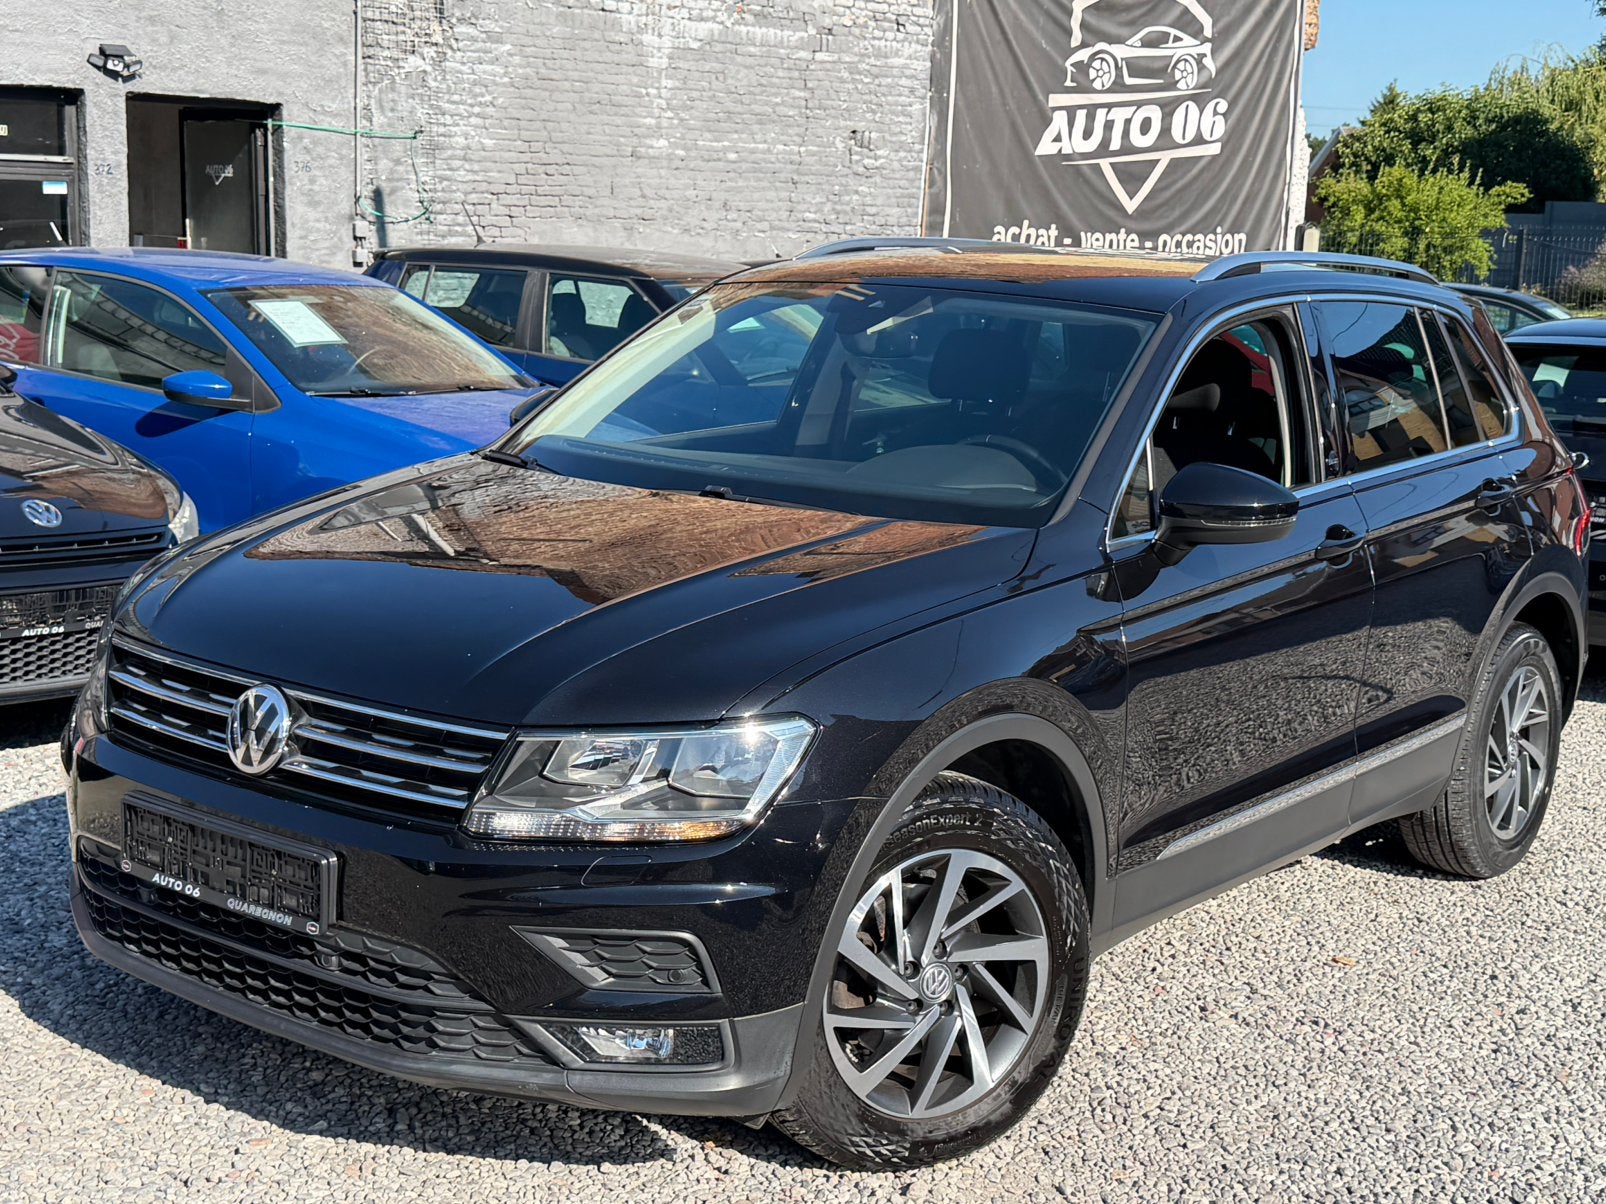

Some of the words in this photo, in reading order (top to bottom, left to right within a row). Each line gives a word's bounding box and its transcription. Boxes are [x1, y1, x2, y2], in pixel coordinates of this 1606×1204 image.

[1035, 104, 1162, 155] AUTO
[1171, 98, 1229, 144] 06
[992, 219, 1058, 247] achat
[1080, 228, 1140, 250] vente
[1158, 226, 1247, 255] occasion
[21, 627, 50, 637] AUTO
[51, 626, 65, 634] 06
[152, 873, 183, 892] AUTO
[186, 884, 201, 898] 06
[227, 898, 293, 926] QUAREGNON
